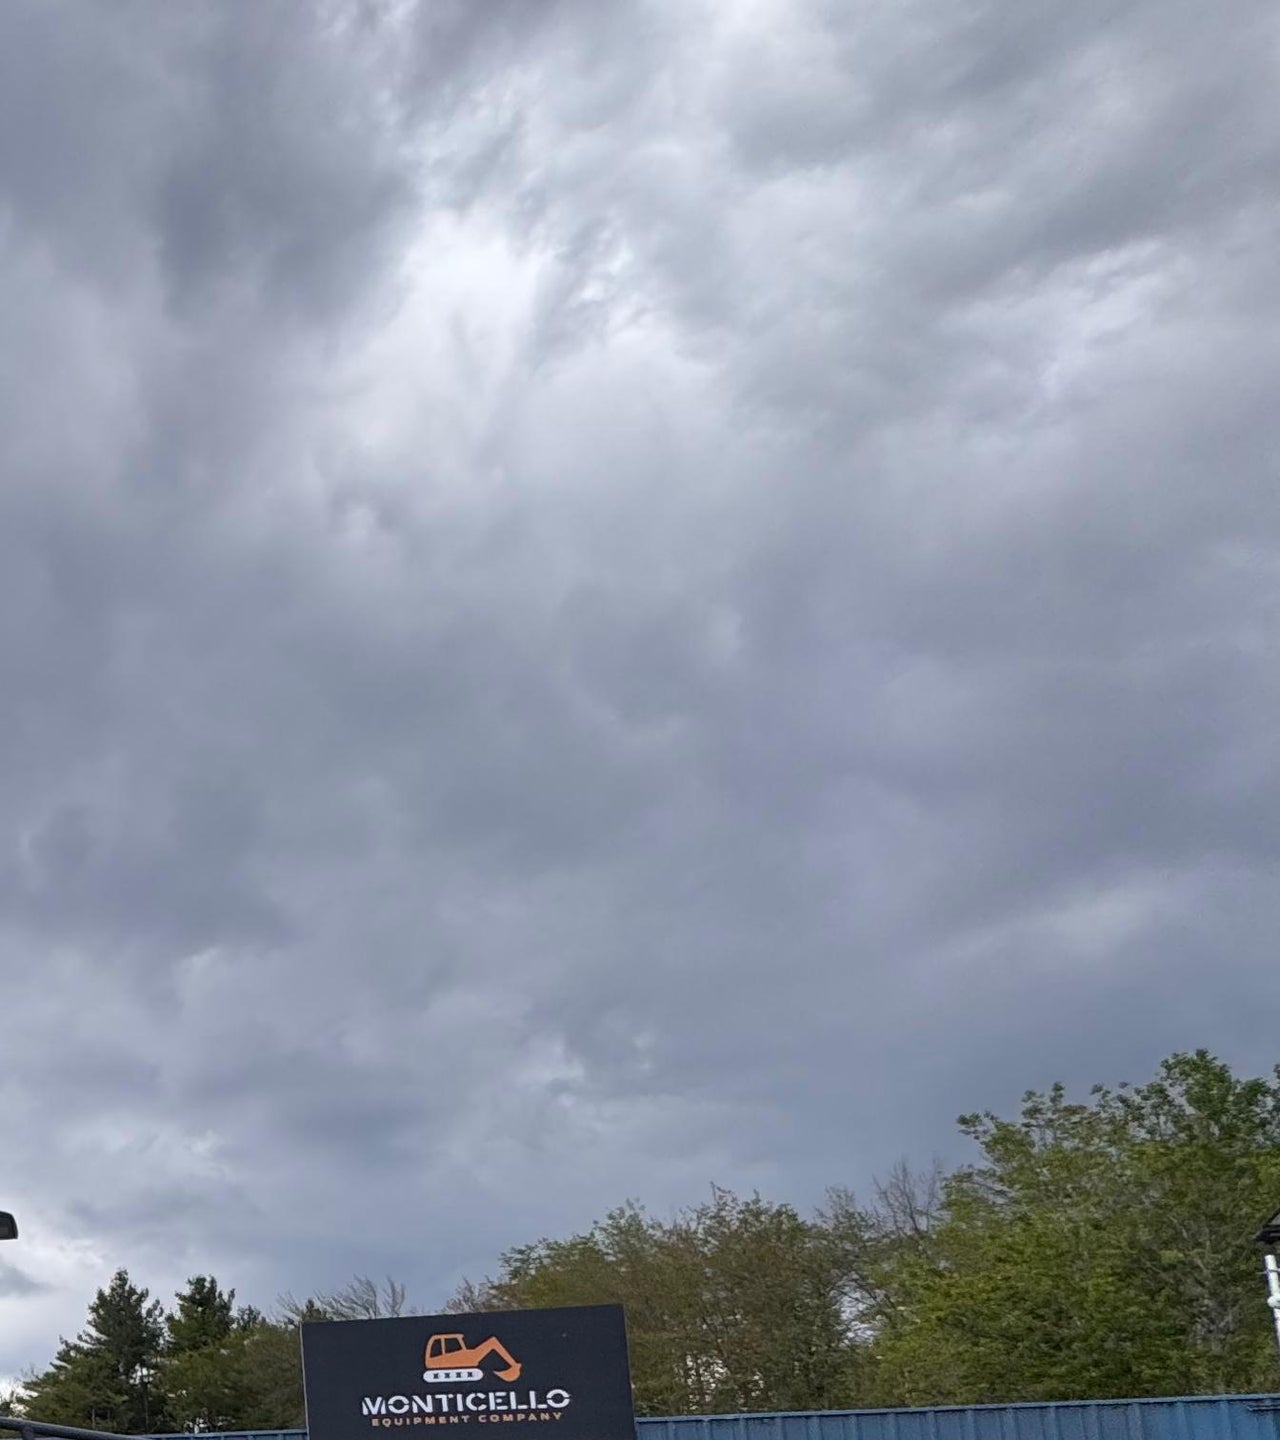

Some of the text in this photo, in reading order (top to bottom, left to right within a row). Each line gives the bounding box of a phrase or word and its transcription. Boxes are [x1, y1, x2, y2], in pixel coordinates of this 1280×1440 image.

[361, 1388, 571, 1416] MONTICELLO
[371, 1411, 563, 1427] EQUIPMENT COMPANY
